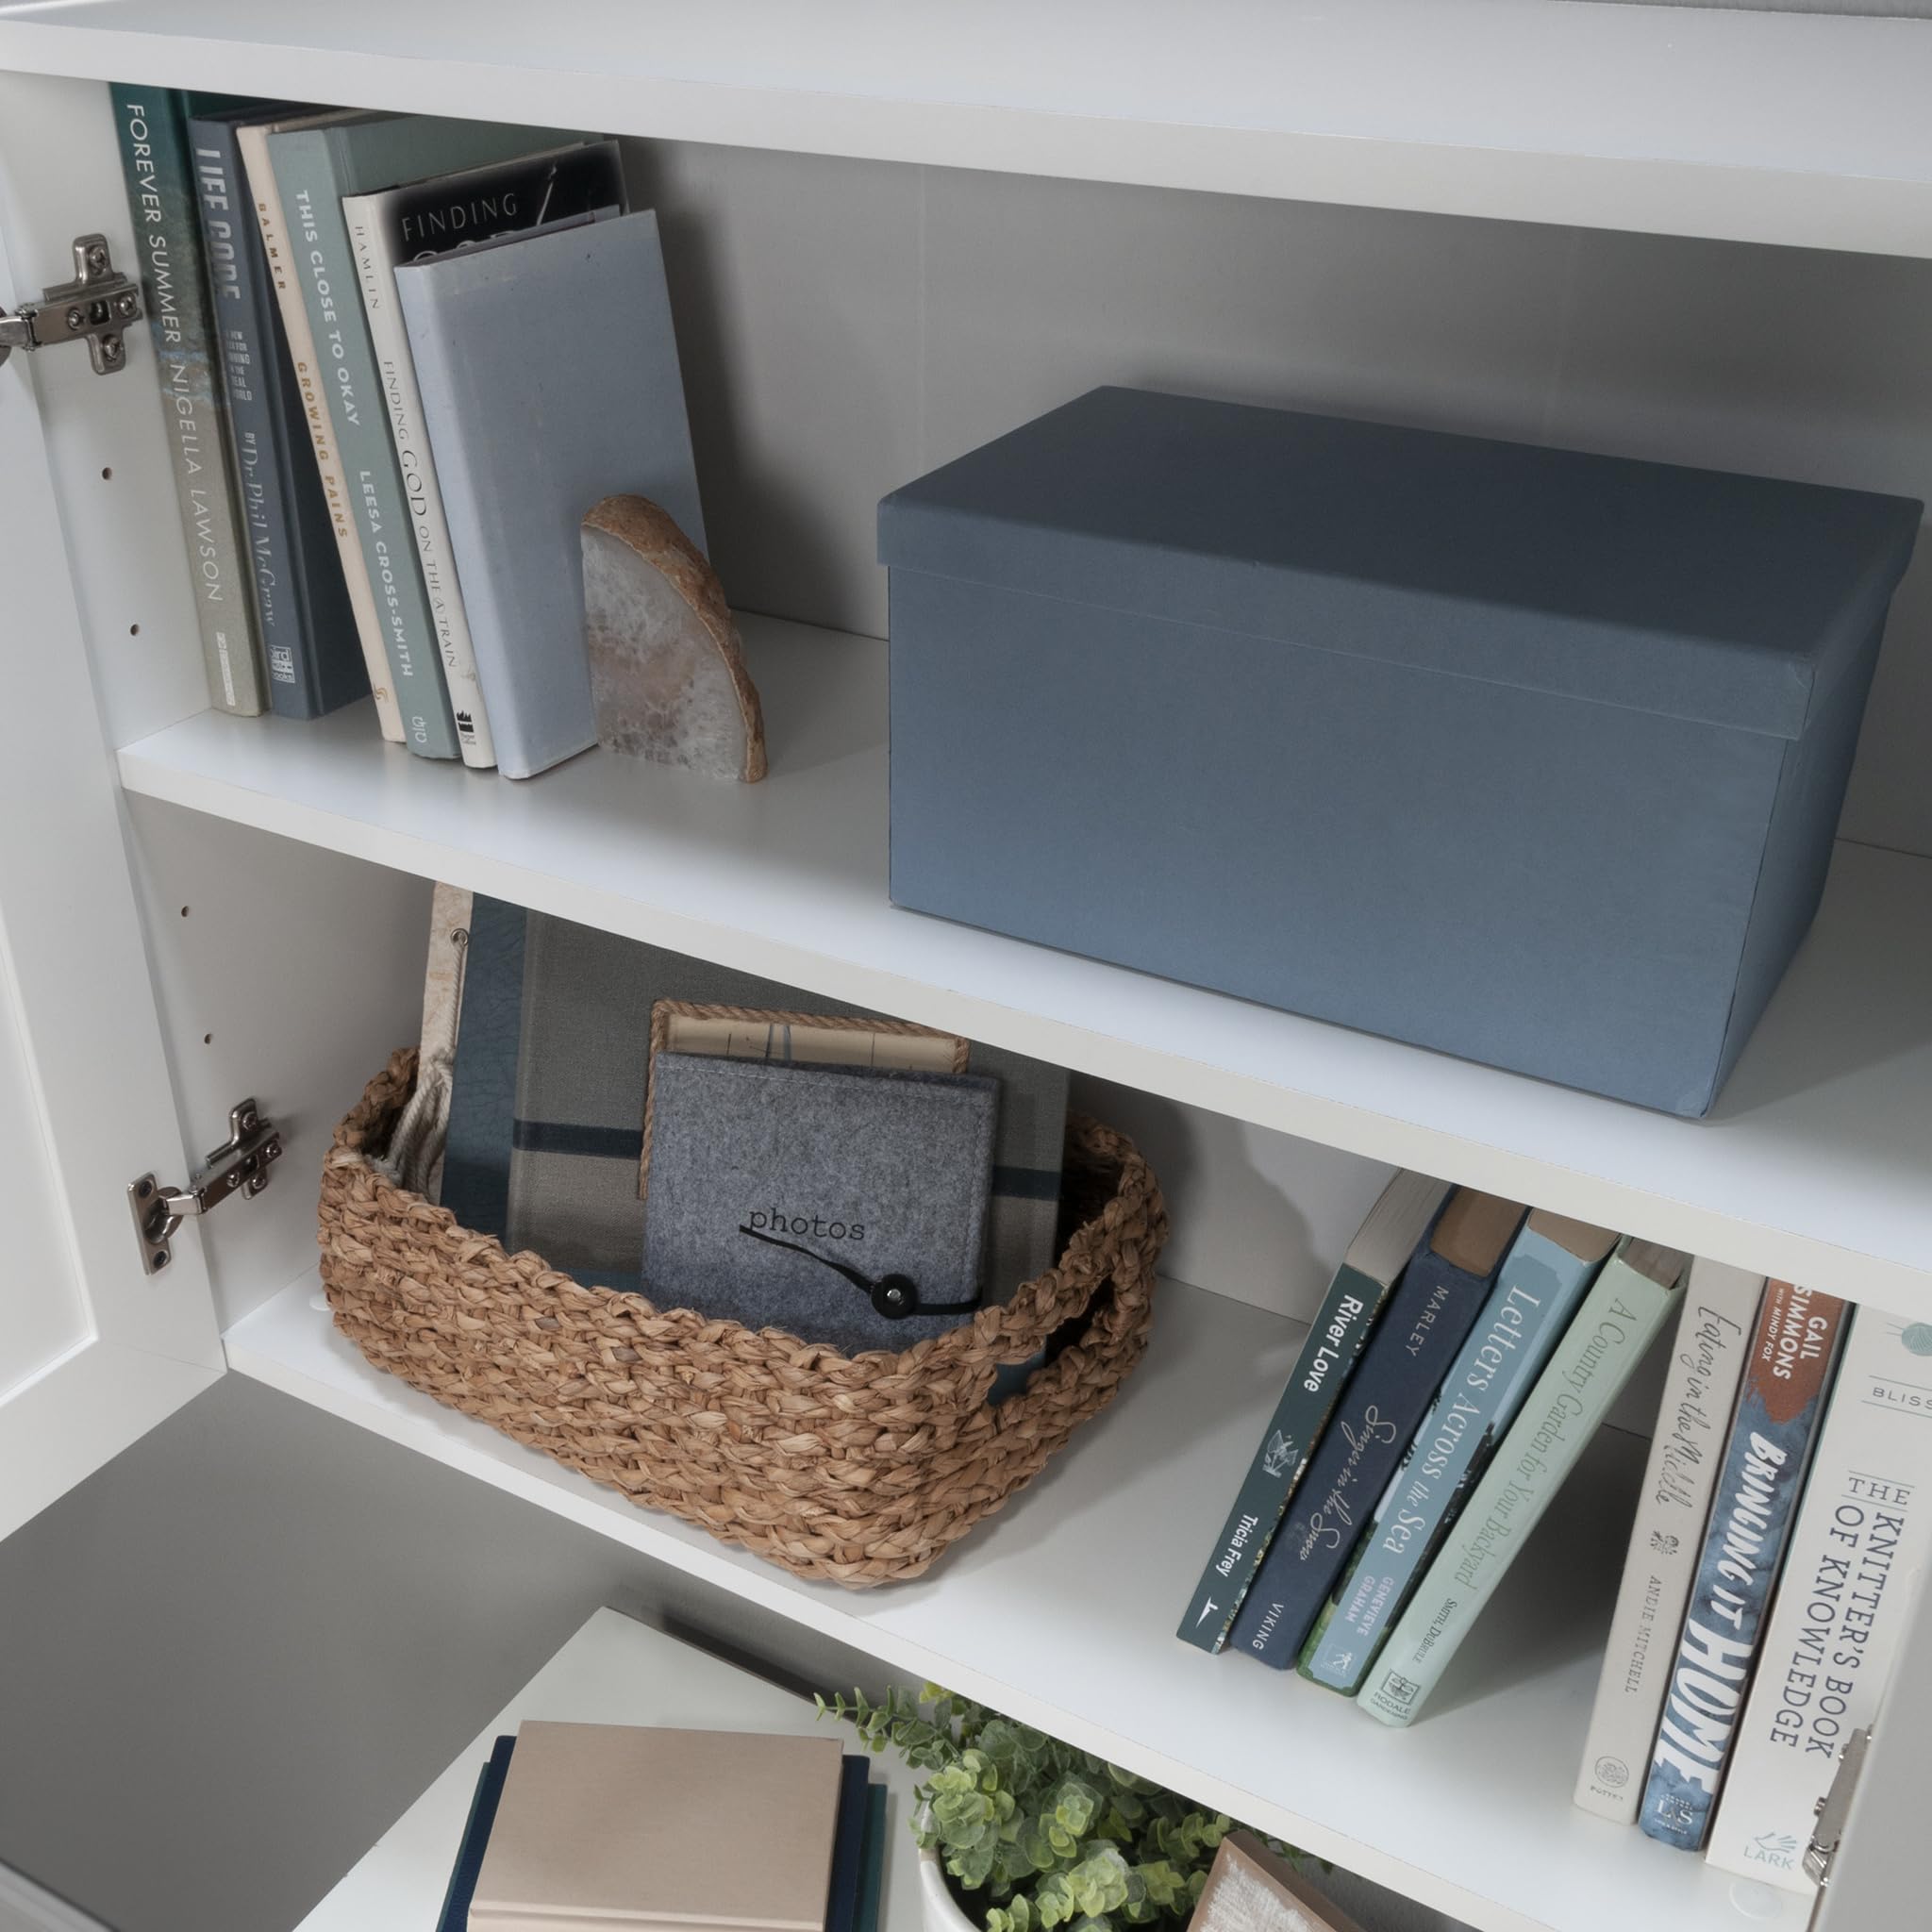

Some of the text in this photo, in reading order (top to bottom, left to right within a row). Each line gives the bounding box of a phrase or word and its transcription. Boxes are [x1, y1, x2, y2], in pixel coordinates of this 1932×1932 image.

[126, 103, 181, 342] FOREVER SUMMER
[258, 202, 287, 290] BALMER
[401, 192, 518, 242] FINDING
[355, 225, 381, 309] HAMLIN
[295, 190, 361, 426] THIS CLOSE TO OKAY
[245, 432, 256, 445] BY
[383, 360, 408, 441] FINDING
[169, 363, 223, 602] NIGELLA LAWSON
[297, 361, 348, 539] GROWING PAINS
[402, 450, 427, 517] GOD
[246, 484, 268, 527] Phil
[419, 525, 434, 553] ON
[255, 537, 276, 627] McGraw
[359, 471, 414, 677] LEESA CROSS-SMITH
[425, 560, 441, 591] THE
[439, 620, 458, 668] TRAIN
[749, 1208, 866, 1241] photos
[1304, 1294, 1363, 1392] River Love
[1406, 1286, 1449, 1357] MARLEY
[1761, 1341, 1774, 1361] FOX
[1768, 1307, 1781, 1341] MINDY
[1773, 1284, 1812, 1379] SIMMONS
[1800, 1316, 1827, 1358] GAIL
[1382, 1284, 1541, 1555] Letters Across the Sea
[1454, 1297, 1640, 1591] A Country Garden for Your Backyard
[1656, 1306, 1742, 1508] Eating in the Middle
[1299, 1406, 1397, 1561] Singer in the Snow
[1717, 1431, 1788, 1586] BRINGING
[1847, 1476, 1911, 1507] THE
[1216, 1514, 1258, 1577] Tricia Frey
[1253, 1603, 1284, 1650] VIKING
[1344, 1576, 1375, 1623] GRAHAM
[1357, 1576, 1394, 1637] GENEVIEVE
[1624, 1574, 1663, 1694] ANDIE MITCHELL
[1710, 1584, 1745, 1631] IT
[1770, 1506, 1865, 1747] OF KNOWLEDGE
[1806, 1511, 1905, 1758] KNITTER'S BOOK
[1653, 1620, 1754, 1794] HOME
[1743, 1846, 1795, 1870] LARK
